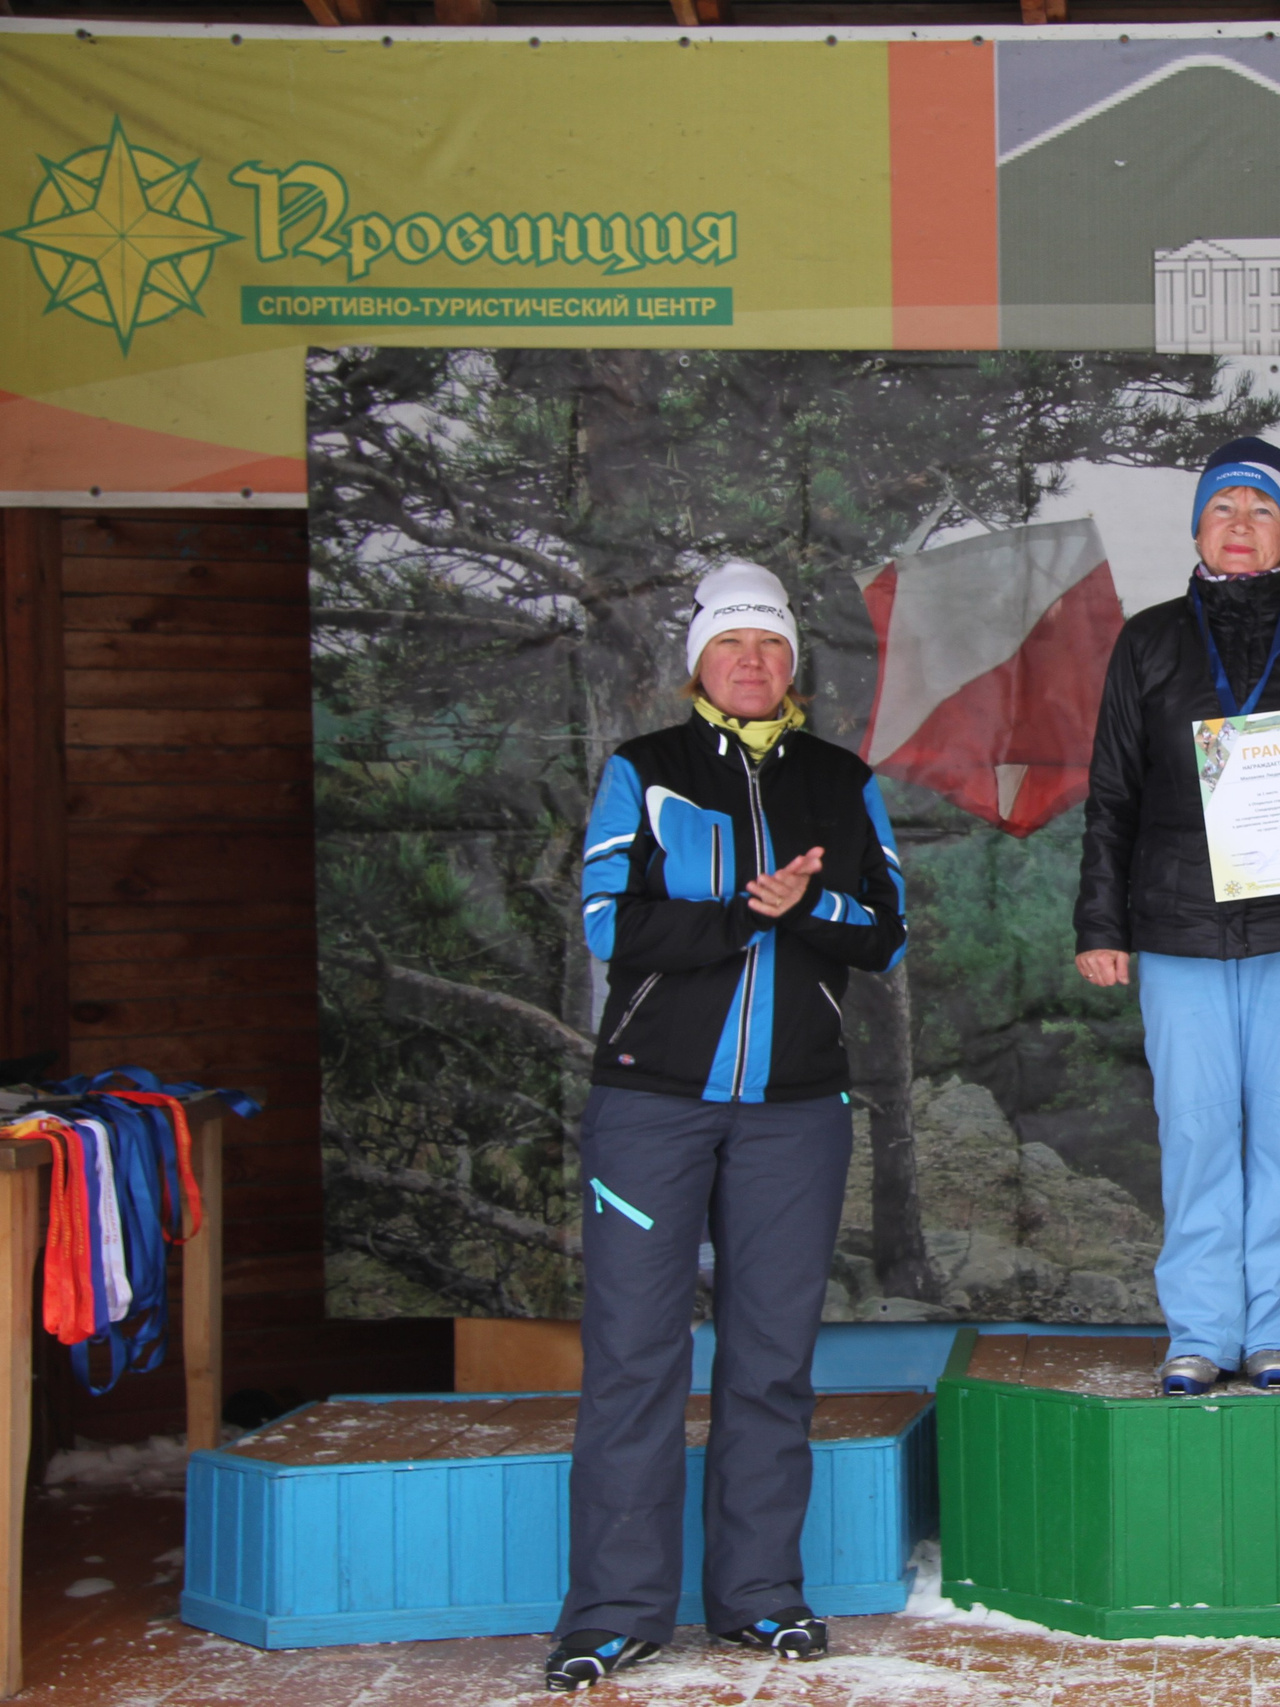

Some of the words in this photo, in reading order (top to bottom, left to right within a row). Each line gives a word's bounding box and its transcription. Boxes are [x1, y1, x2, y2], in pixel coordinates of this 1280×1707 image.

[228, 160, 737, 283] Провинция
[257, 294, 629, 317] СПОРТИВНО-ТУРИСТИЧЕСКИЙ
[636, 297, 717, 319] ЦЕНТР
[713, 603, 778, 619] FISCHER
